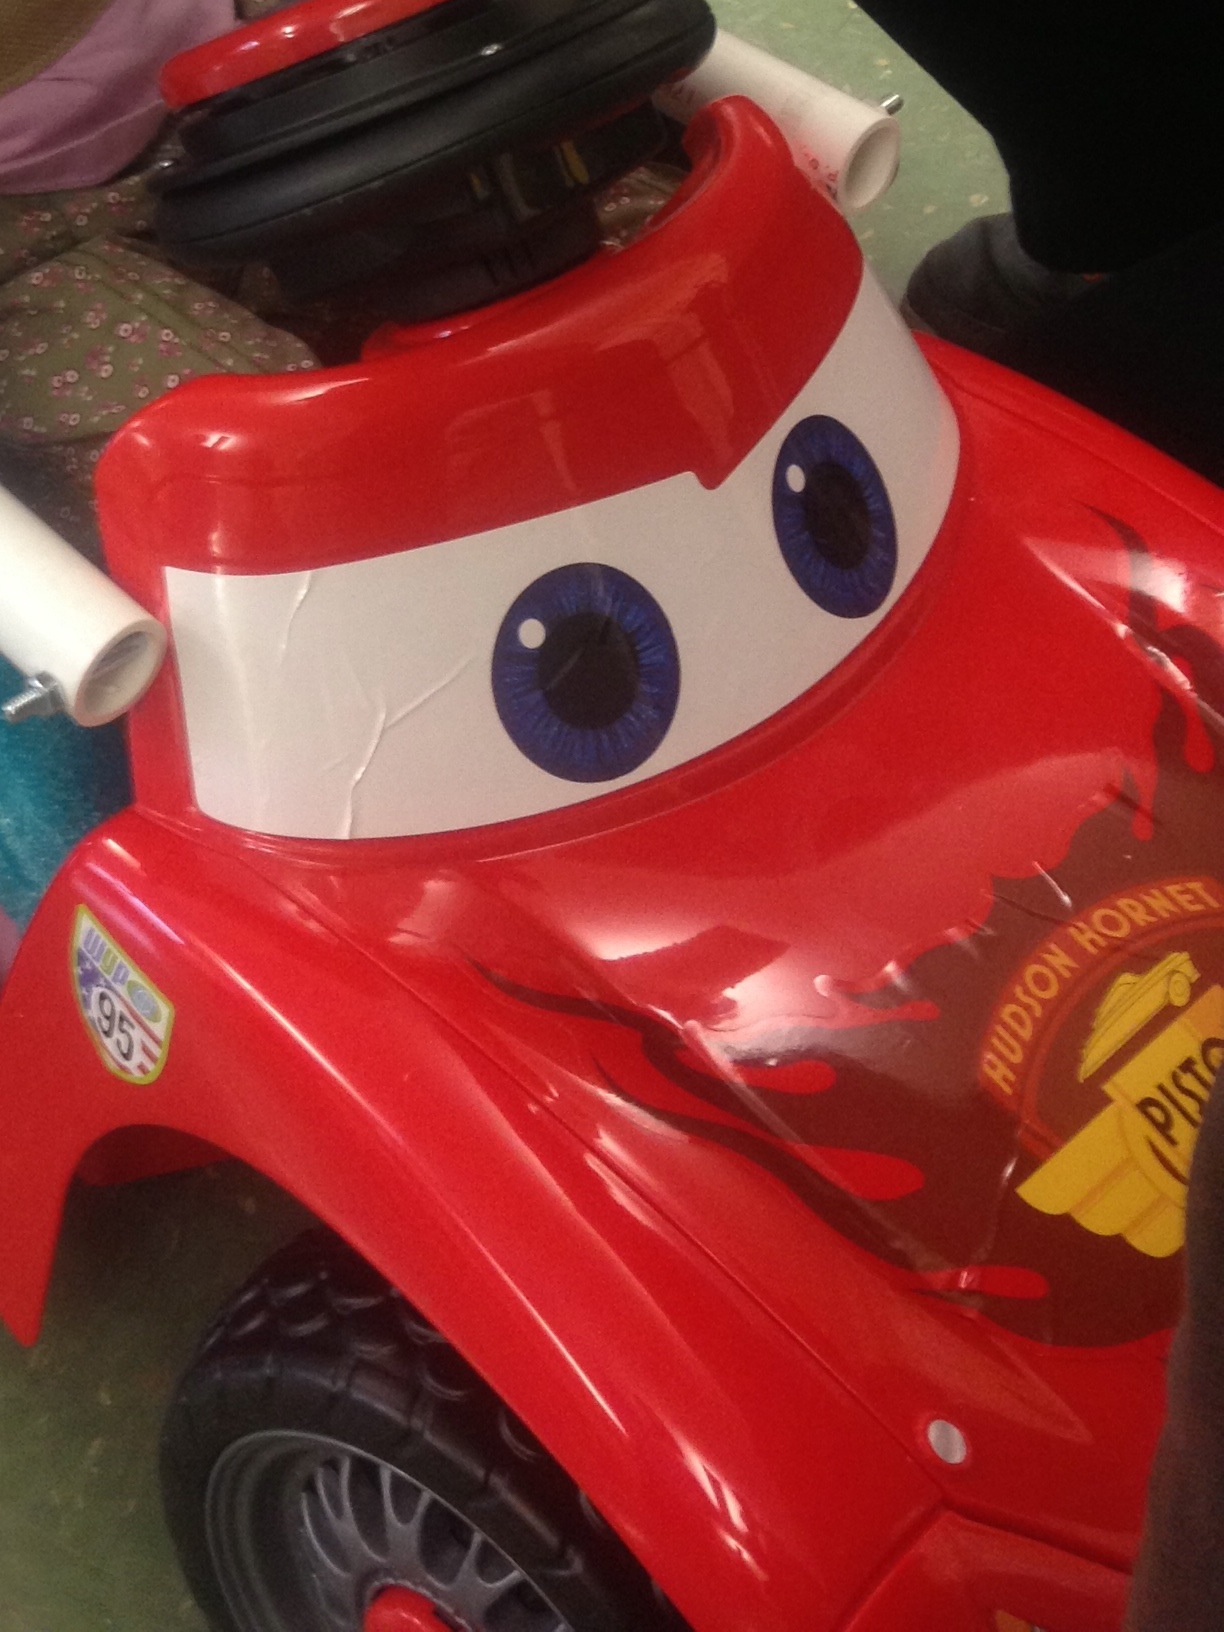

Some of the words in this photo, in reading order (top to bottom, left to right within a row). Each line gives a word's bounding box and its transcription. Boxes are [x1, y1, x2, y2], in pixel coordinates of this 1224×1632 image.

[97, 990, 136, 1062] 95
[981, 942, 1080, 1095] HUDSON
[1068, 881, 1221, 955] HORNET
